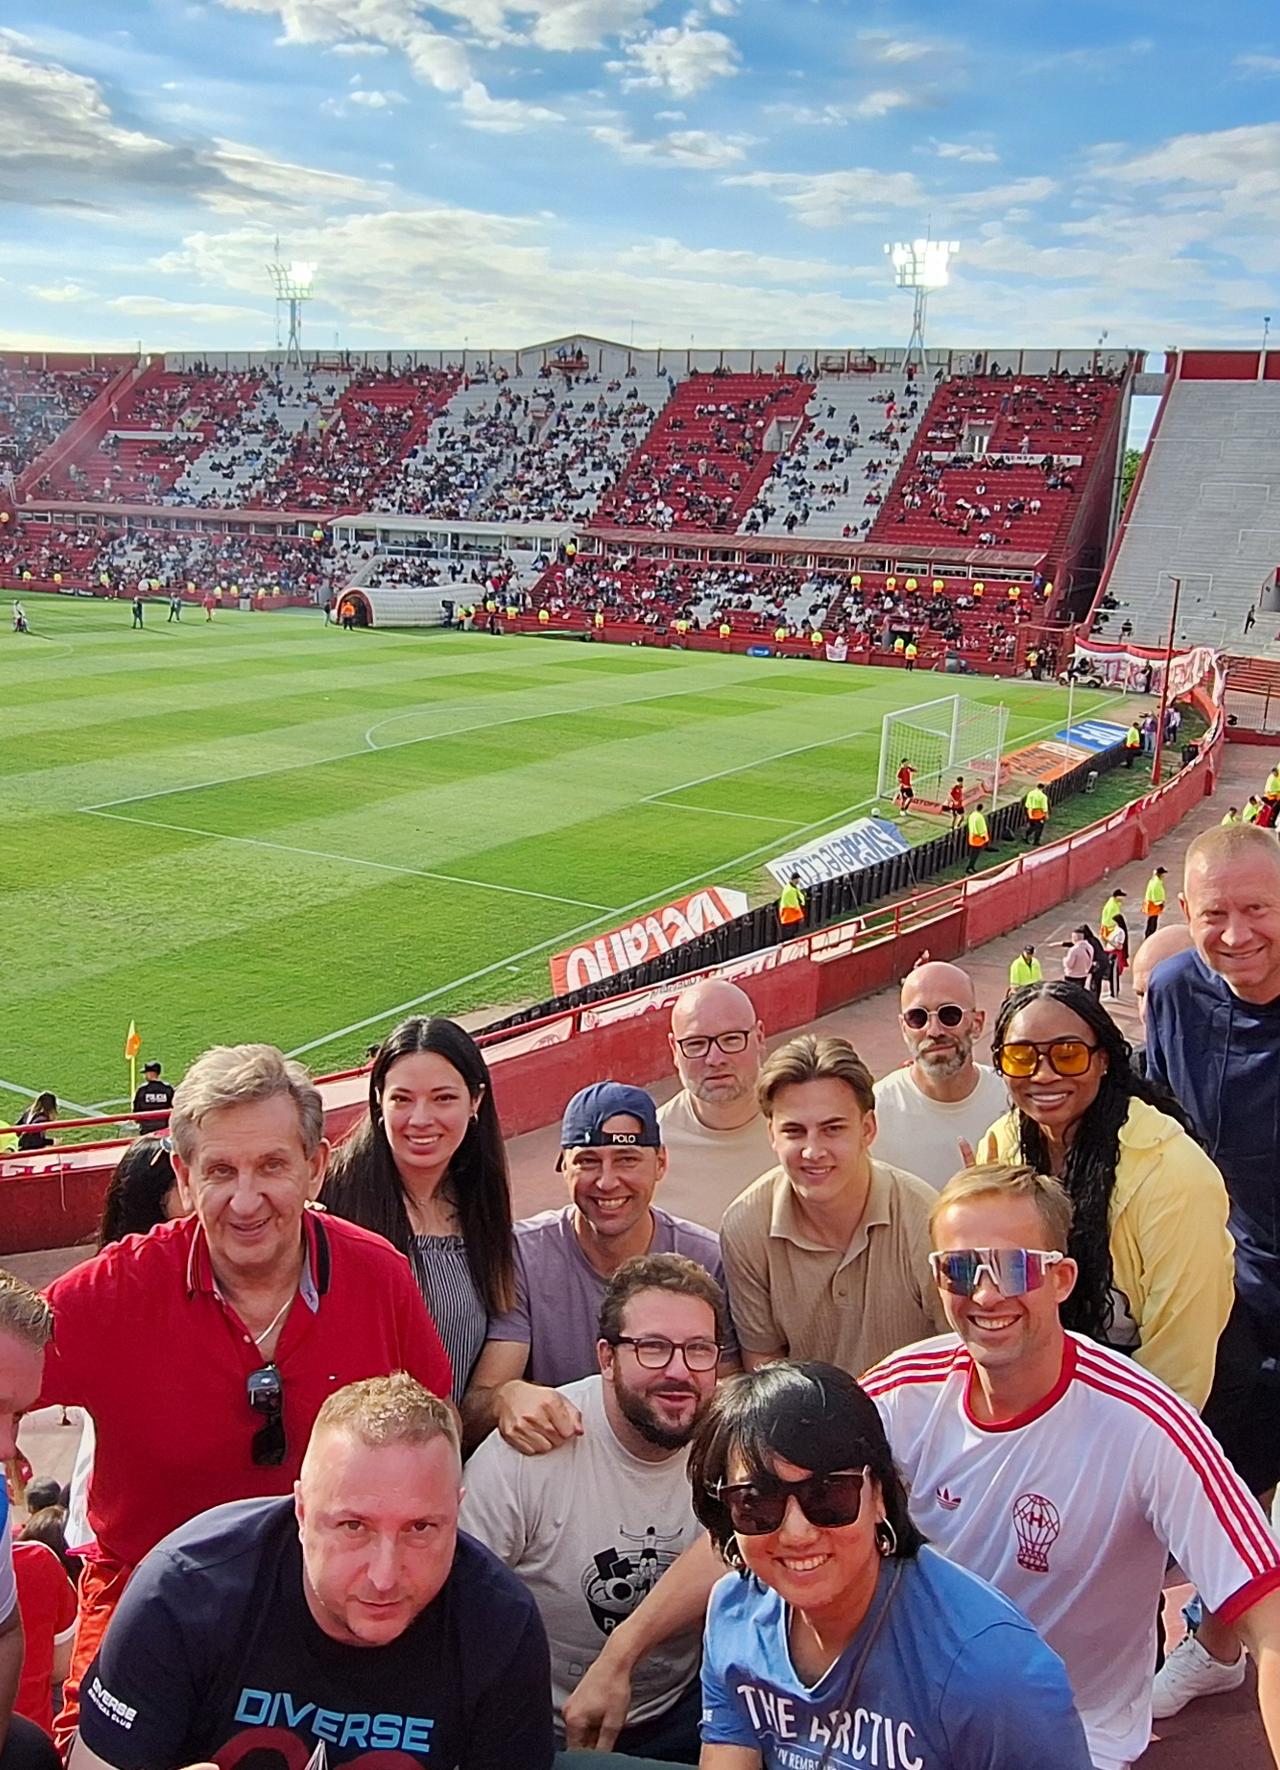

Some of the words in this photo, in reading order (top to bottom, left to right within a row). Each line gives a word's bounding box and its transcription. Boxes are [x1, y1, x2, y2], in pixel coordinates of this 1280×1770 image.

[613, 1134, 636, 1143] POLO
[92, 1676, 138, 1722] DIVERSE
[111, 1713, 132, 1730] CLUB
[234, 1687, 435, 1753] DIVERSE
[737, 1684, 798, 1739] THE
[809, 1707, 924, 1770] ARCTIC
